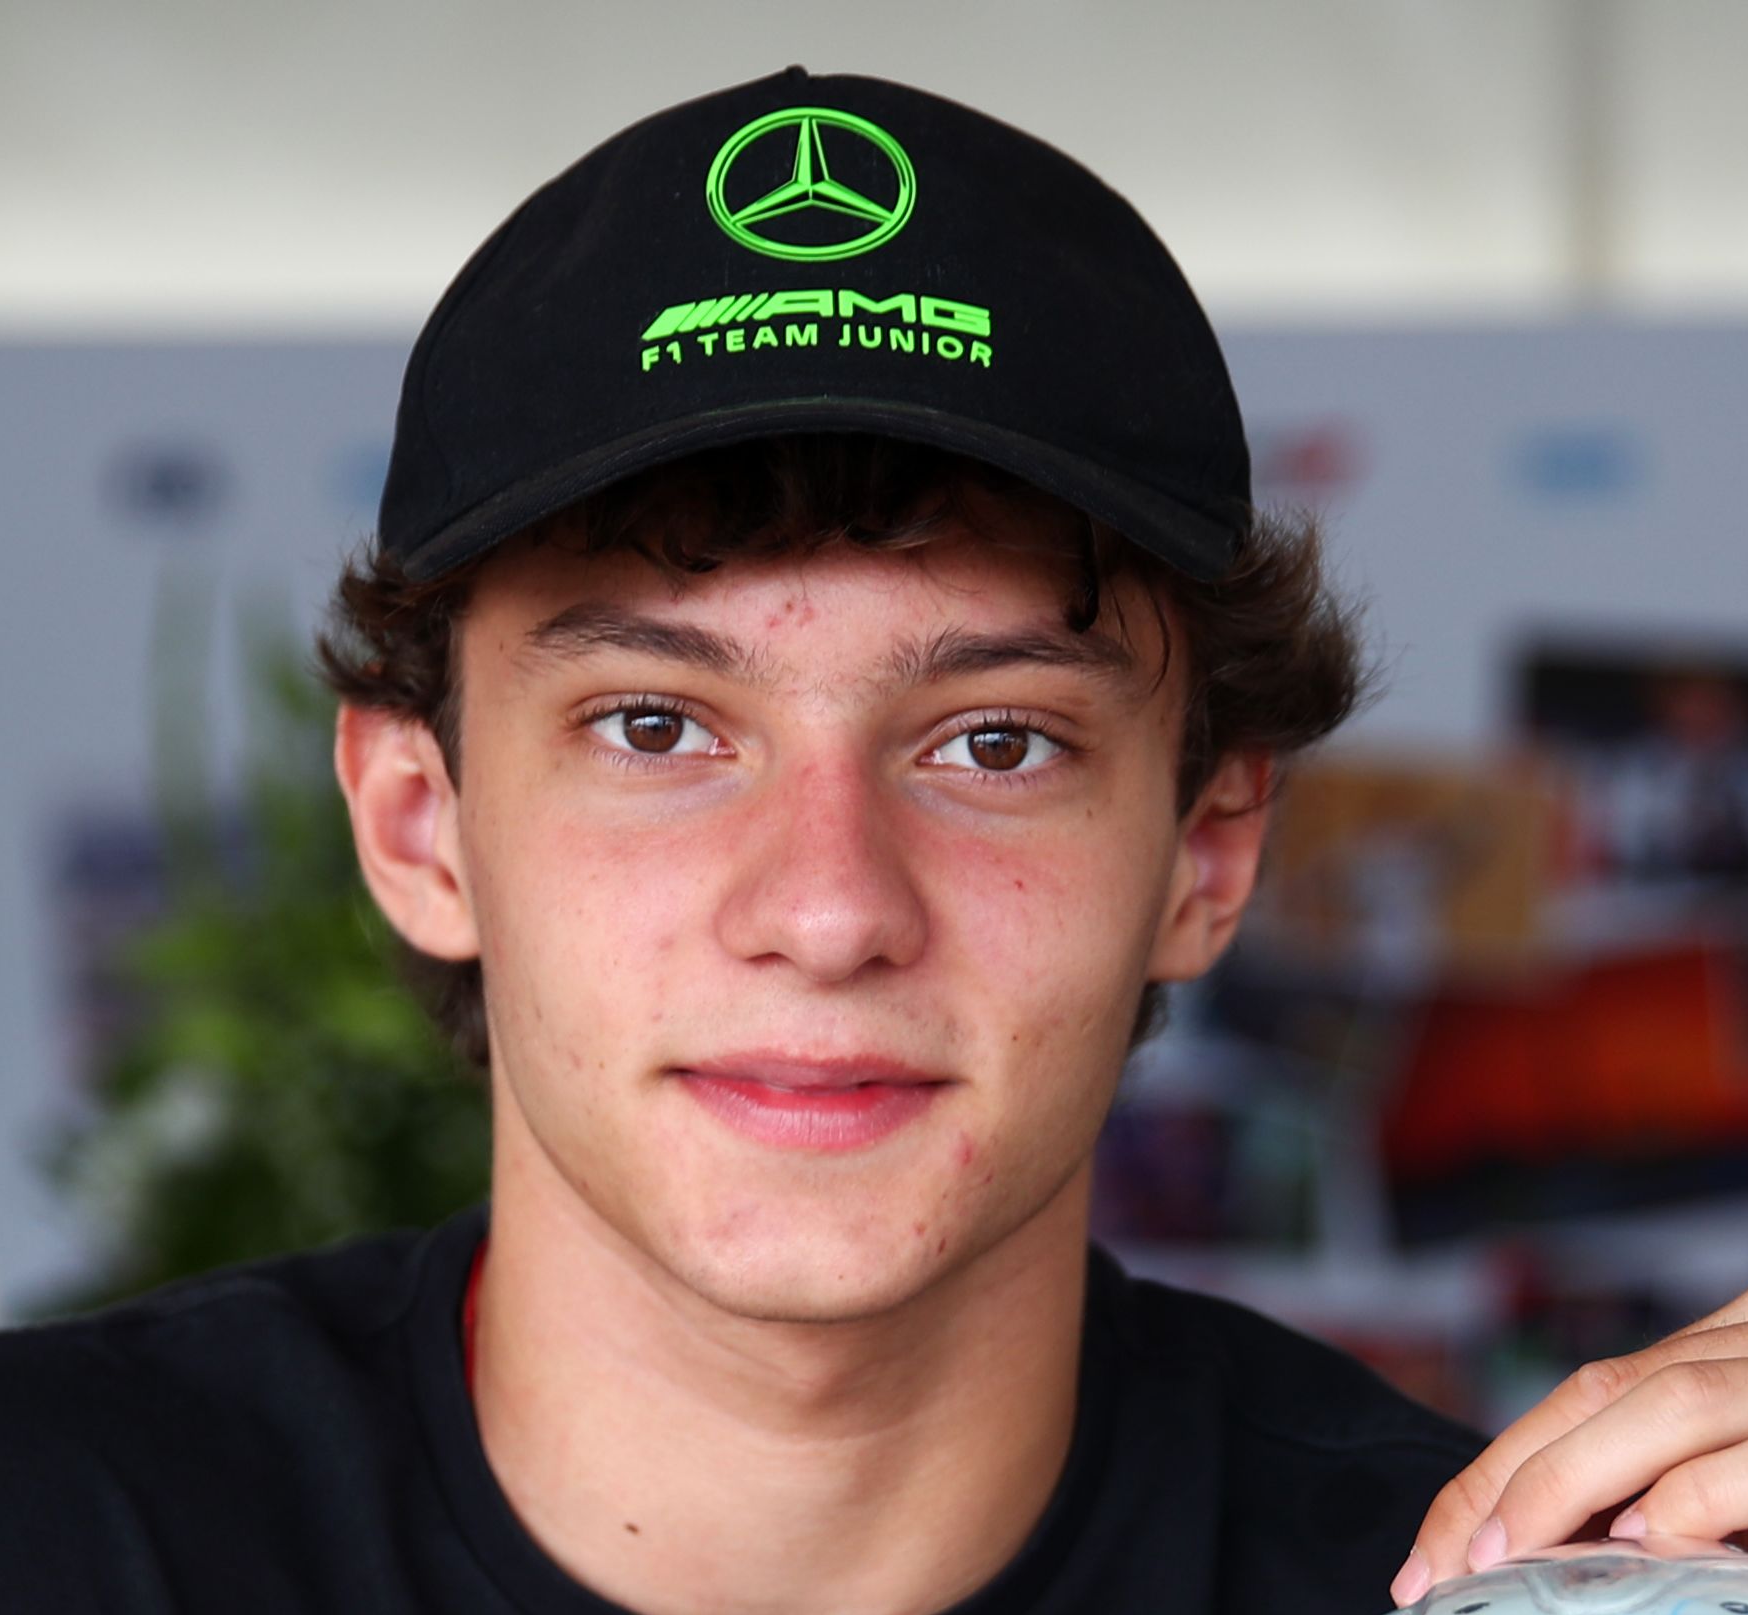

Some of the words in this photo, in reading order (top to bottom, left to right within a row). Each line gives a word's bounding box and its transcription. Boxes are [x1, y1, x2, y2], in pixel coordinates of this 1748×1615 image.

[753, 288, 992, 338] AMG
[641, 340, 683, 372] F1
[696, 322, 819, 357] TEAM
[837, 323, 994, 368] JUNIOR
